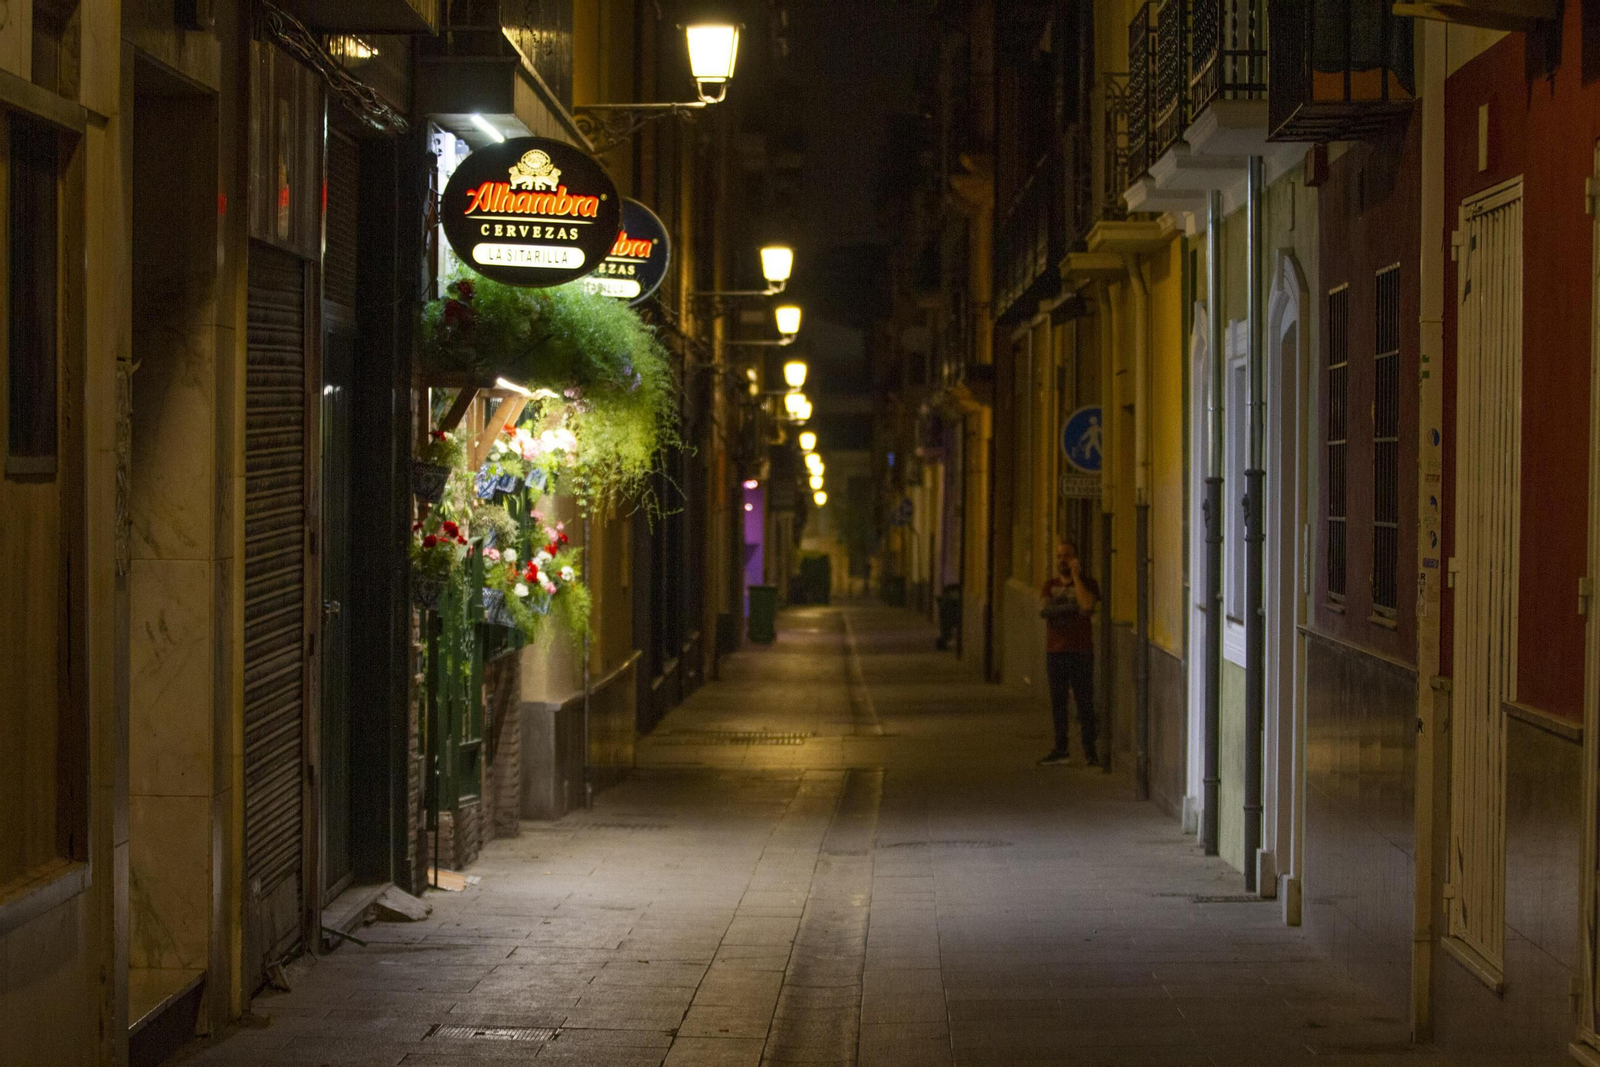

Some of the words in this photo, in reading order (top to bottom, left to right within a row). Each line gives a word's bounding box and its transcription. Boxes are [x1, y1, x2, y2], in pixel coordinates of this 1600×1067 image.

[463, 180, 599, 218] Alhambra
[481, 223, 579, 240] CERVEZAS
[488, 248, 502, 261] LA
[507, 249, 569, 264] SITARILLA
